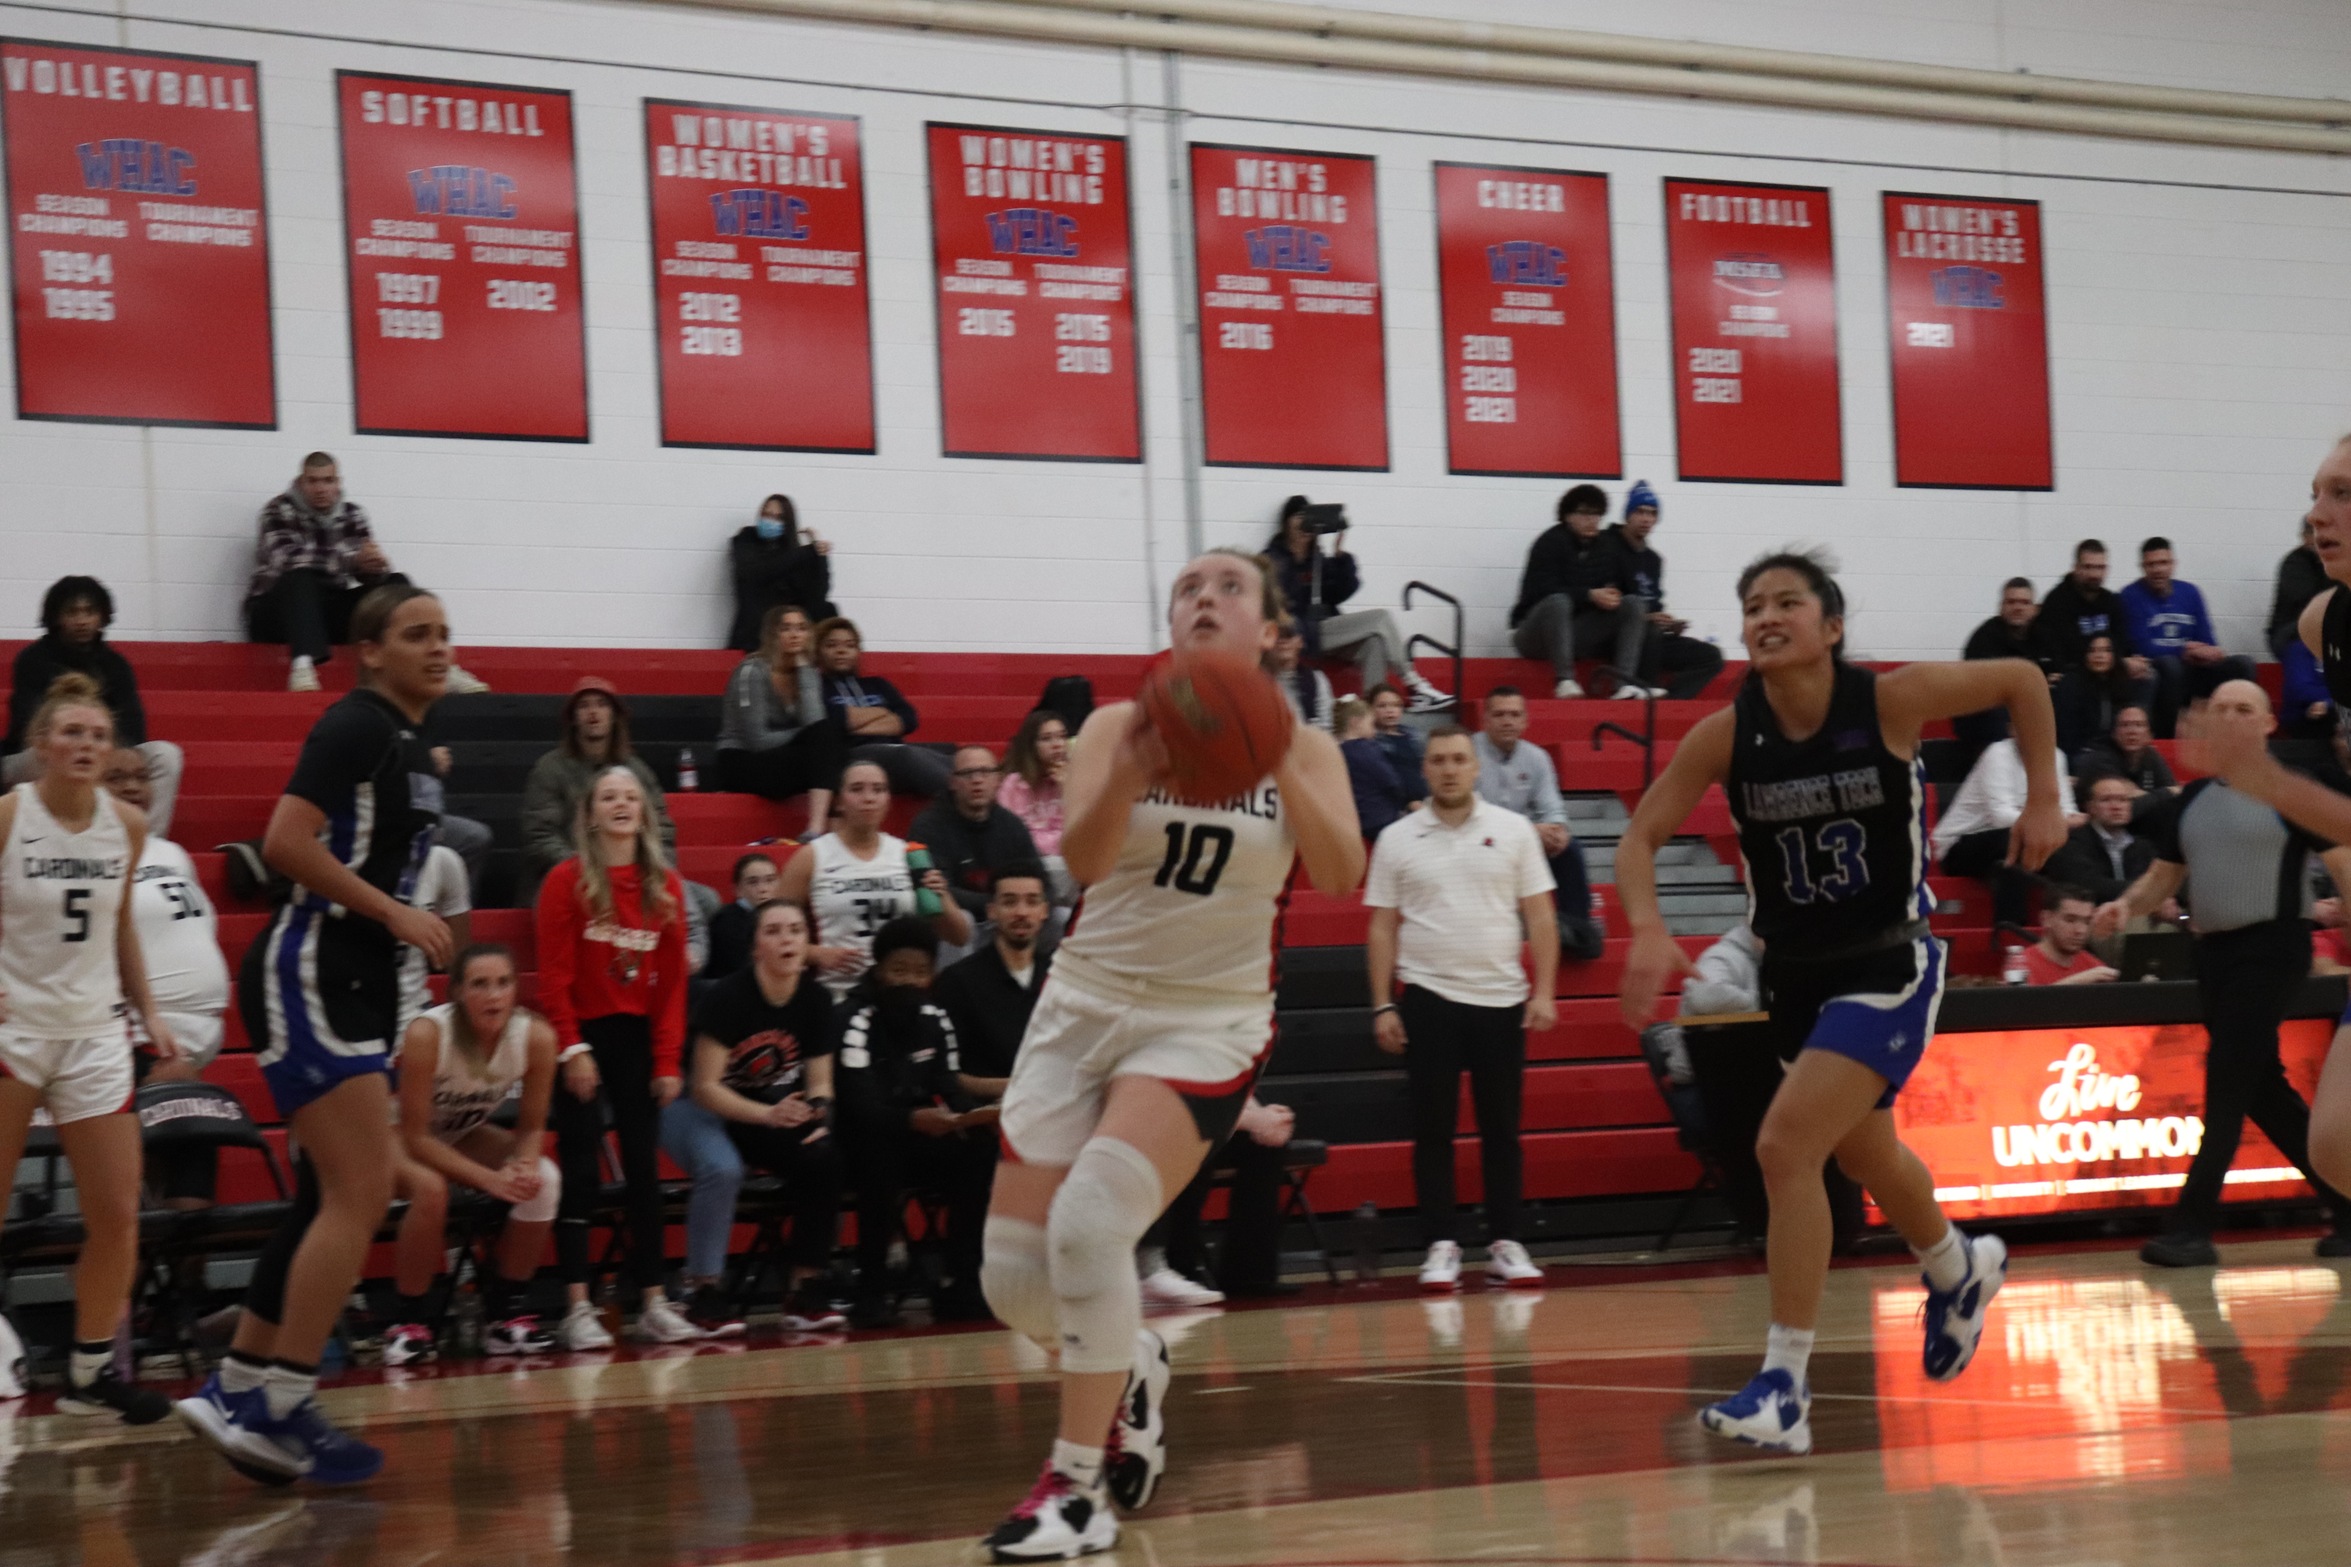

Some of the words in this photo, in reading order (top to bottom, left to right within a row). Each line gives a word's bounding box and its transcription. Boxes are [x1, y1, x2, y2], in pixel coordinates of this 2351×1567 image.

[2, 57, 254, 112] VOLLEYBALL
[360, 90, 544, 137] SOFTBALL
[671, 113, 829, 156] WOMEN'S
[75, 137, 197, 196] WHAC
[656, 145, 848, 189] BASKETBALL
[959, 135, 1105, 174] WOMEN'S
[406, 164, 518, 220] WHAC
[964, 166, 1103, 205] BOWLING
[1235, 158, 1327, 193] MEN'S
[35, 194, 110, 217] SEASON
[1216, 187, 1347, 223] BOWLING
[1477, 180, 1565, 213] CHEER
[1679, 193, 1812, 228] FOOTBALL
[18, 213, 129, 238] CHAMPIONS
[137, 201, 258, 226] TOURNAMENT
[370, 218, 439, 239] SEASON
[708, 188, 811, 240] WHAC
[1901, 203, 2018, 236] WOMEN'S
[145, 222, 254, 247] CHAMPIONS
[355, 237, 455, 260] CHAMPIONS
[463, 224, 573, 248] TOURNAMENT
[984, 207, 1079, 258] WHAC
[1244, 224, 1332, 273] WHAC
[1896, 231, 2026, 264] LACROSSE
[39, 249, 114, 284] 1994
[470, 245, 568, 268] CHAMPIONS
[675, 240, 738, 260] SEASON
[760, 245, 861, 268] TOURNAMENT
[1485, 240, 1569, 287] WHAC
[661, 258, 754, 280] CHAMPIONS
[766, 265, 857, 287] CHAMPIONS
[955, 258, 1014, 277] SEASON
[1032, 262, 1127, 283] TOURNAMENT
[375, 272, 440, 304] 1997
[485, 278, 558, 311] 2002
[942, 275, 1028, 296] CHAMPIONS
[1039, 281, 1123, 302] CHAMPIONS
[1204, 291, 1284, 311] CHAMPIONS
[1289, 278, 1378, 298] TOURNAMENT
[42, 287, 117, 321] 1995
[678, 291, 742, 323] 2012
[1295, 296, 1374, 315] CHAMPIONS
[1490, 307, 1566, 326] CHAMPIONS
[377, 307, 444, 340] 1999
[958, 307, 1016, 337] 2015
[1055, 312, 1111, 342] 2015
[1219, 321, 1274, 350] 2016
[680, 325, 743, 357] 2013
[1742, 773, 1836, 822] LAWRENCE
[1832, 766, 1885, 812] TECH
[1154, 820, 1235, 897] 10
[1775, 818, 1871, 904] 13
[62, 888, 93, 942] 5
[2039, 1043, 2142, 1121] Live
